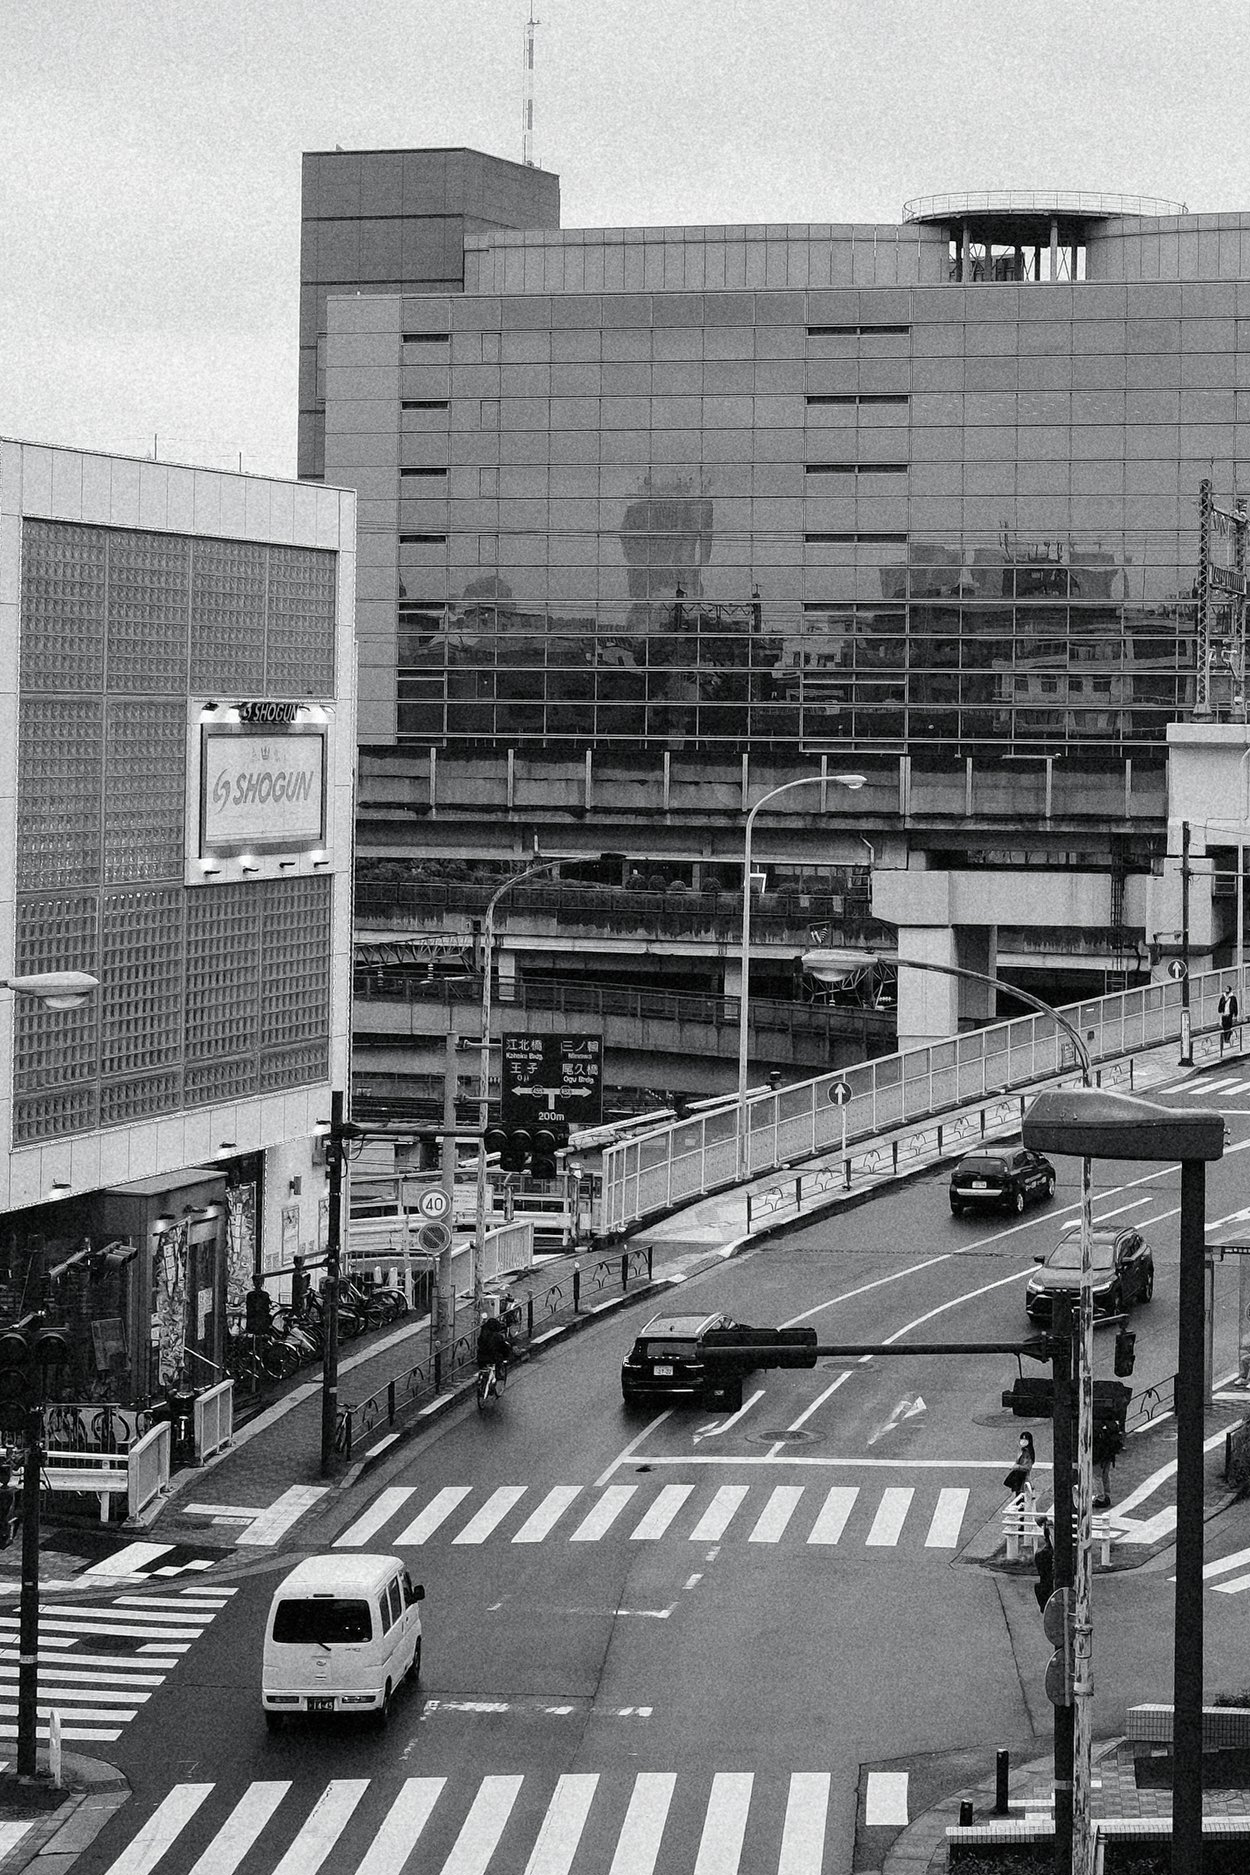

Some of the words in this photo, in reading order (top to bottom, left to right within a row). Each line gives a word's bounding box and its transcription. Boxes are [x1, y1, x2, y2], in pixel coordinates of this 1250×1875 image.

[254, 703, 298, 721] SHOGUN
[233, 771, 314, 805] SHOGUN
[505, 1039, 543, 1051] 江北橋
[562, 1040, 599, 1053] 三ノ輪
[510, 1062, 538, 1074] 王子
[562, 1063, 599, 1076] 尾久橋
[538, 1112, 565, 1121] 200m
[425, 1197, 444, 1211] 40
